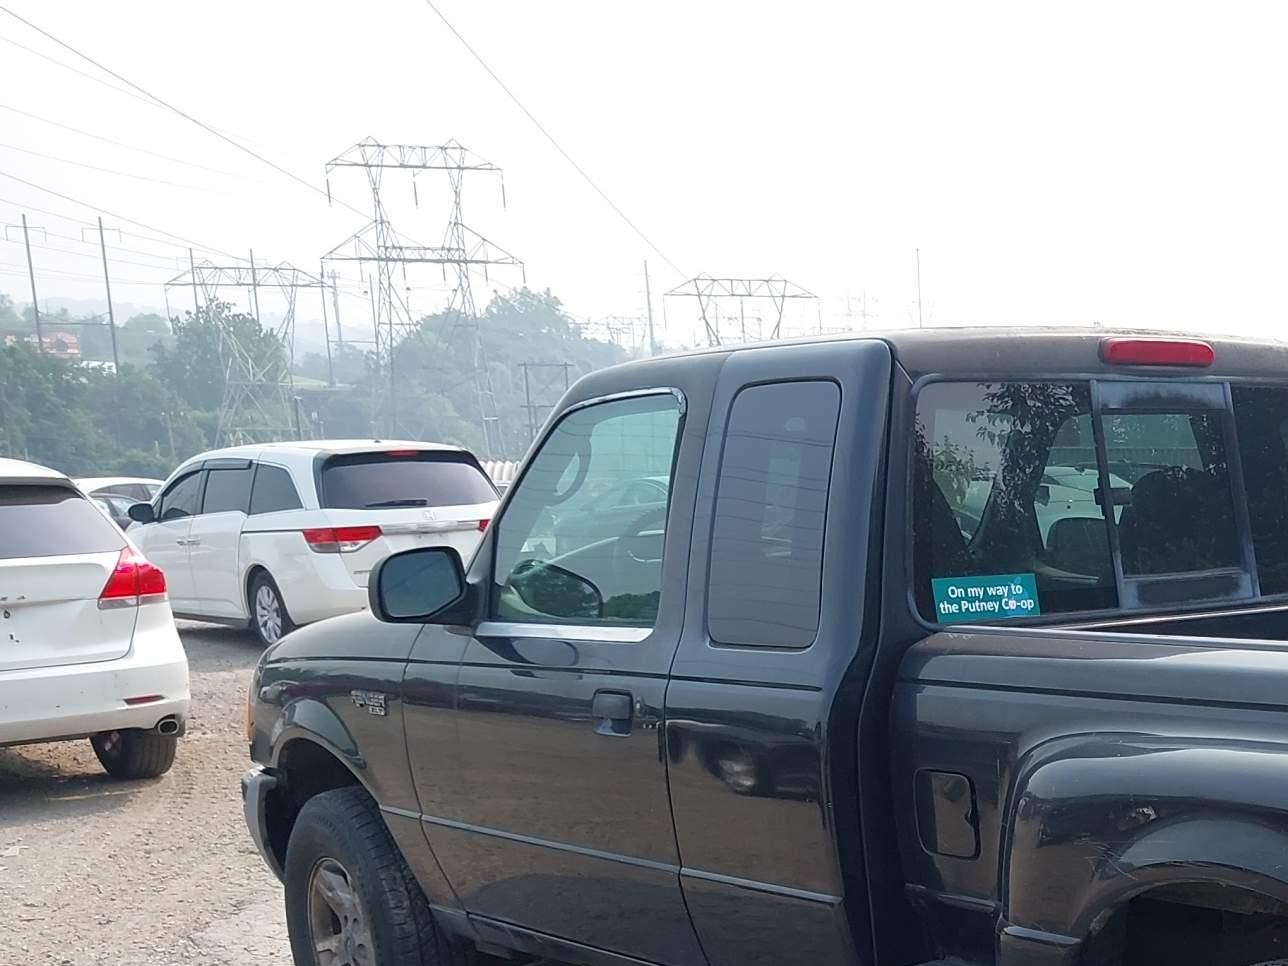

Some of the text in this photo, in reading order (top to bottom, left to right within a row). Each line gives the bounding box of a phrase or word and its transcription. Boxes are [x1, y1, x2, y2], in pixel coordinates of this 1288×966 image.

[948, 584, 1023, 599] On my way to
[940, 598, 1034, 614] the Putney Co-op
